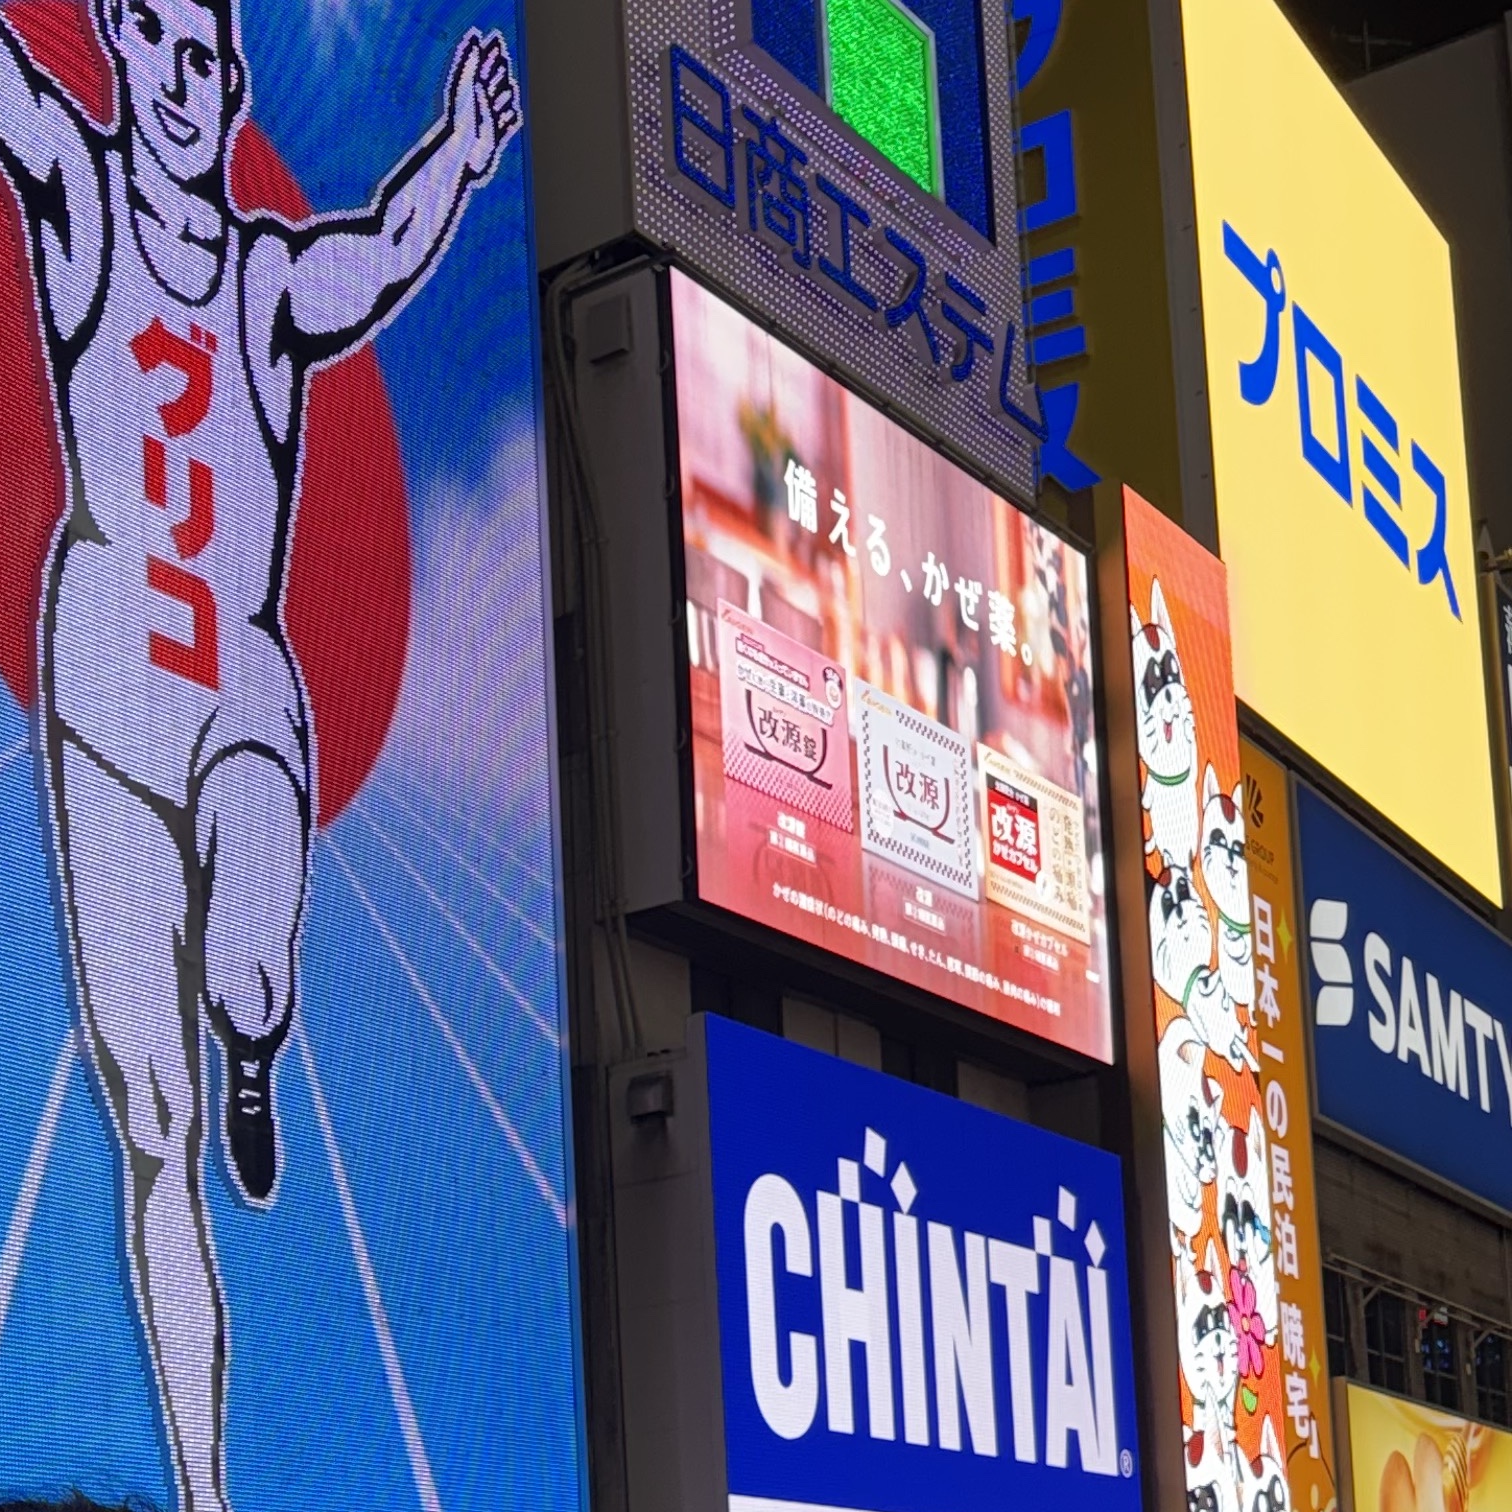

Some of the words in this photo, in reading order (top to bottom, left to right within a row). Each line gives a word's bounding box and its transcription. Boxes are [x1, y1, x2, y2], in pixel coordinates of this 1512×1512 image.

[128, 317, 222, 691] グリコ
[784, 459, 1033, 665] 備える、かぜ薬。
[1223, 220, 1462, 622] プロミス
